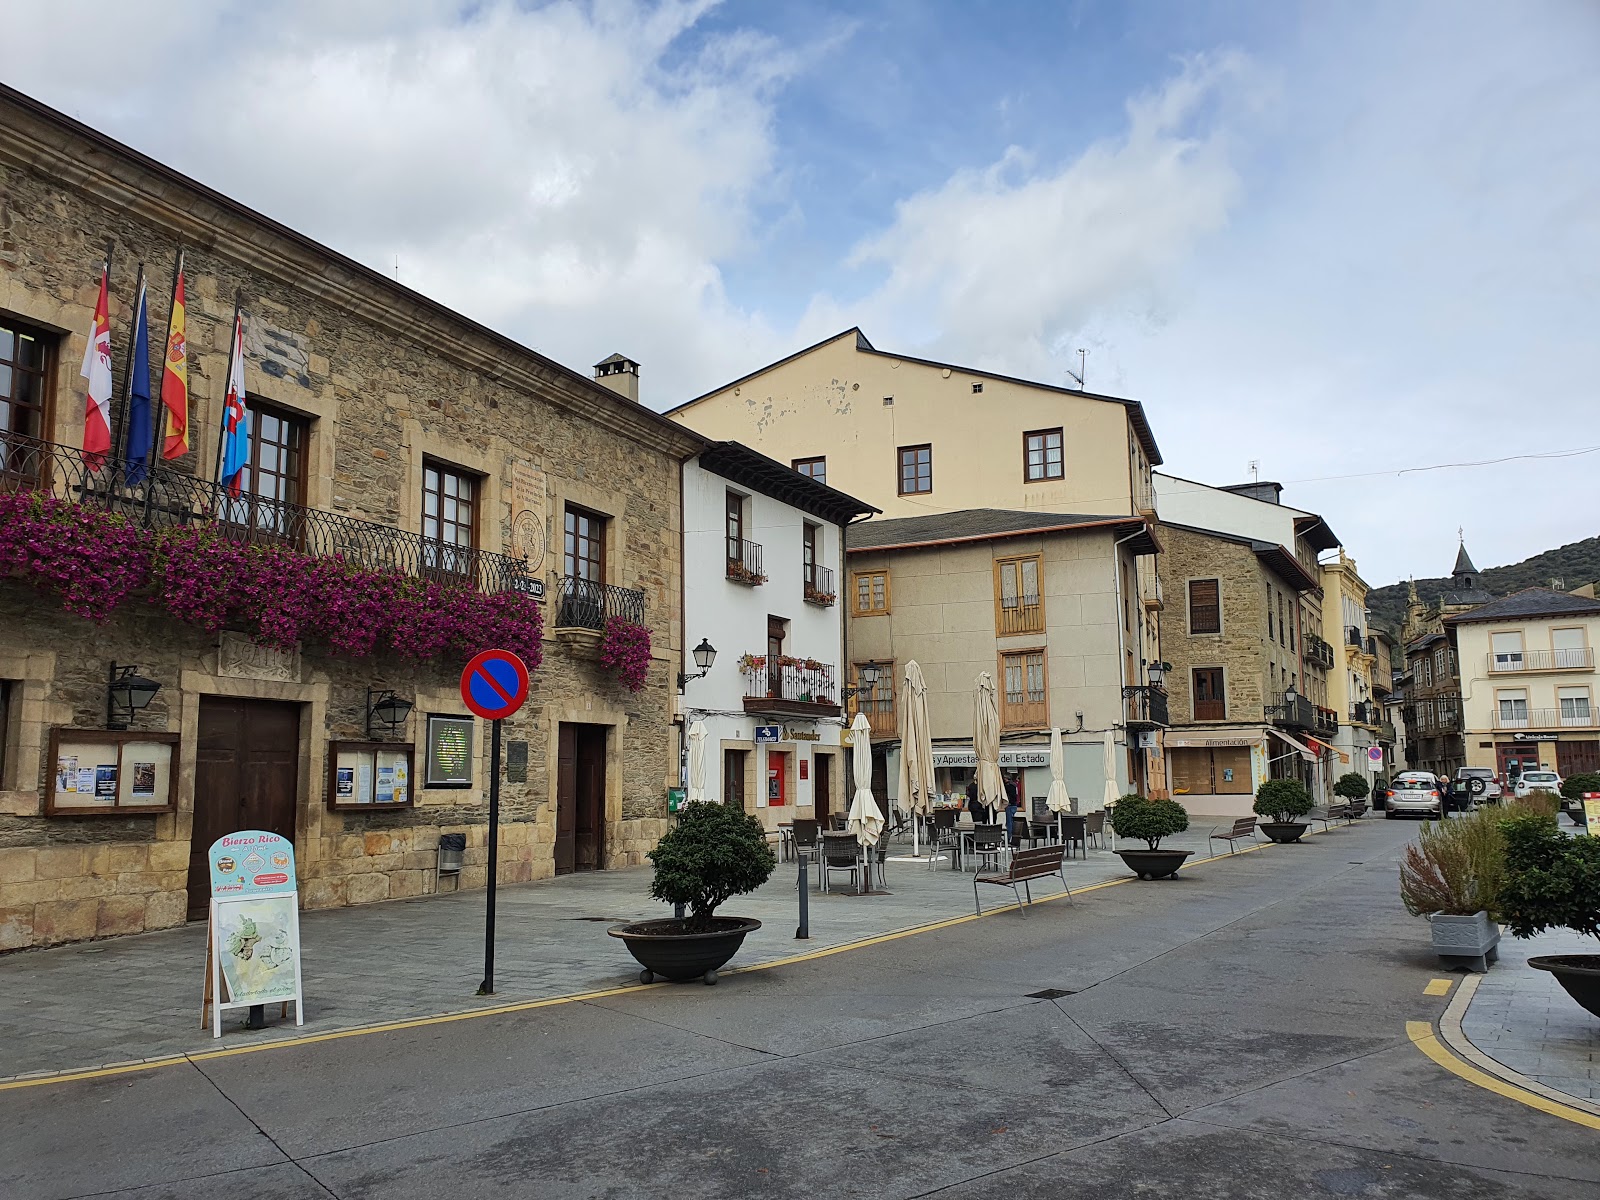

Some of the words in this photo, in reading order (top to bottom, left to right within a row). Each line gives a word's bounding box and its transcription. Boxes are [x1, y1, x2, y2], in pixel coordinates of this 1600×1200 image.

[790, 728, 821, 741] Santander
[1205, 738, 1249, 746] Alimentación
[937, 756, 942, 765] y
[1000, 753, 1013, 763] del
[1015, 753, 1045, 763] Estado
[222, 837, 255, 847] Bierzo
[258, 835, 280, 843] Rico
